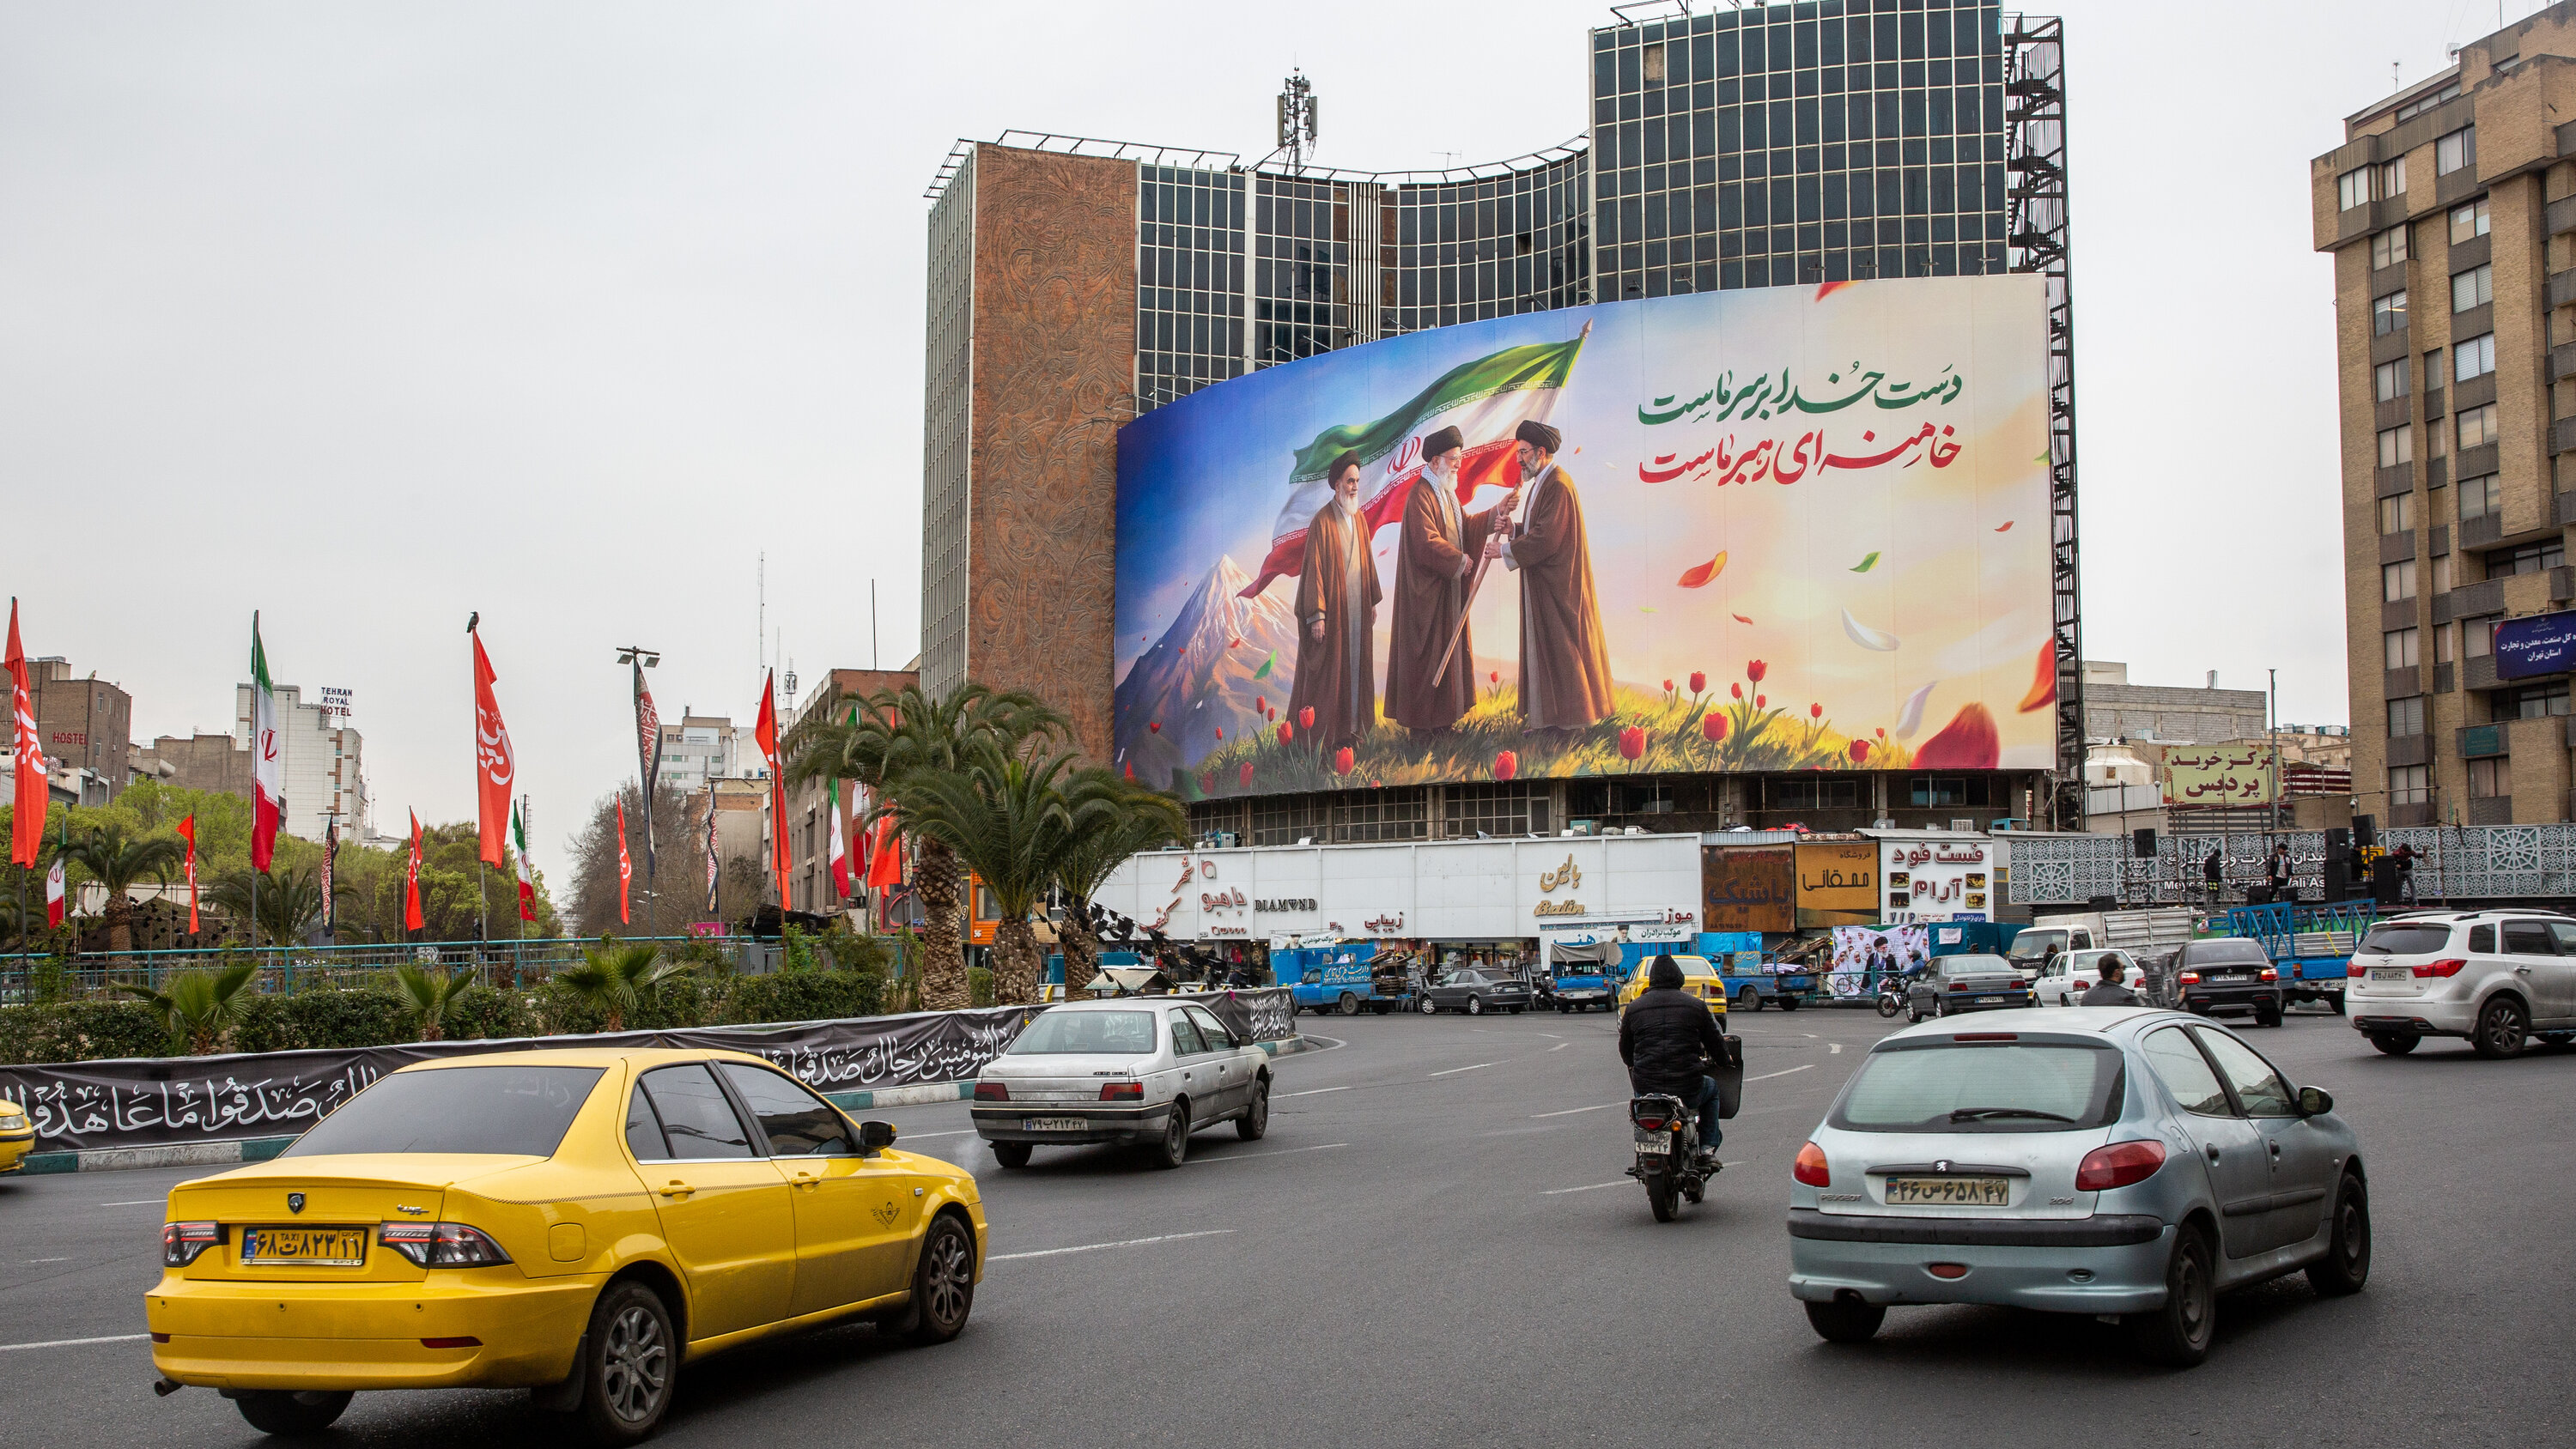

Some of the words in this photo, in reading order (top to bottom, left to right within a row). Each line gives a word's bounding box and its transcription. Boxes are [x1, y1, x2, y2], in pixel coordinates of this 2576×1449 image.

[1637, 369, 1733, 426] ماست
[1716, 373, 1768, 423] سر
[1741, 384, 1772, 425] بر
[1638, 433, 1735, 484] ماست
[1717, 439, 1774, 487] رهبر
[2500, 640, 2519, 652] تجارت
[2524, 640, 2541, 648] معدن
[2527, 650, 2543, 662] تهران
[2544, 648, 2561, 659] استان
[321, 687, 352, 696] TEHRAN
[323, 697, 349, 706] ROYAL
[320, 706, 351, 717] HOTEL
[52, 731, 89, 745] HOSTEL
[2171, 751, 2222, 770] خرید
[2225, 750, 2275, 770] مرکز
[2185, 777, 2260, 797] پردیس
[1839, 850, 1871, 860] فروشگاه
[1892, 841, 1931, 869] فود
[1934, 842, 1984, 864] فست
[1539, 852, 1583, 893] بالین
[1912, 876, 1963, 903] آرام
[1200, 885, 1248, 917] بامبو
[1534, 899, 1586, 917] Balin
[1364, 911, 1405, 933] زیبایی
[1664, 907, 1694, 925] موز
[1889, 912, 1917, 924] VIP
[1641, 929, 1663, 938] برادران
[1820, 1193, 1862, 1202] PEUGEOT
[2049, 1197, 2075, 1205] 206
[280, 1233, 300, 1241] TAXI
